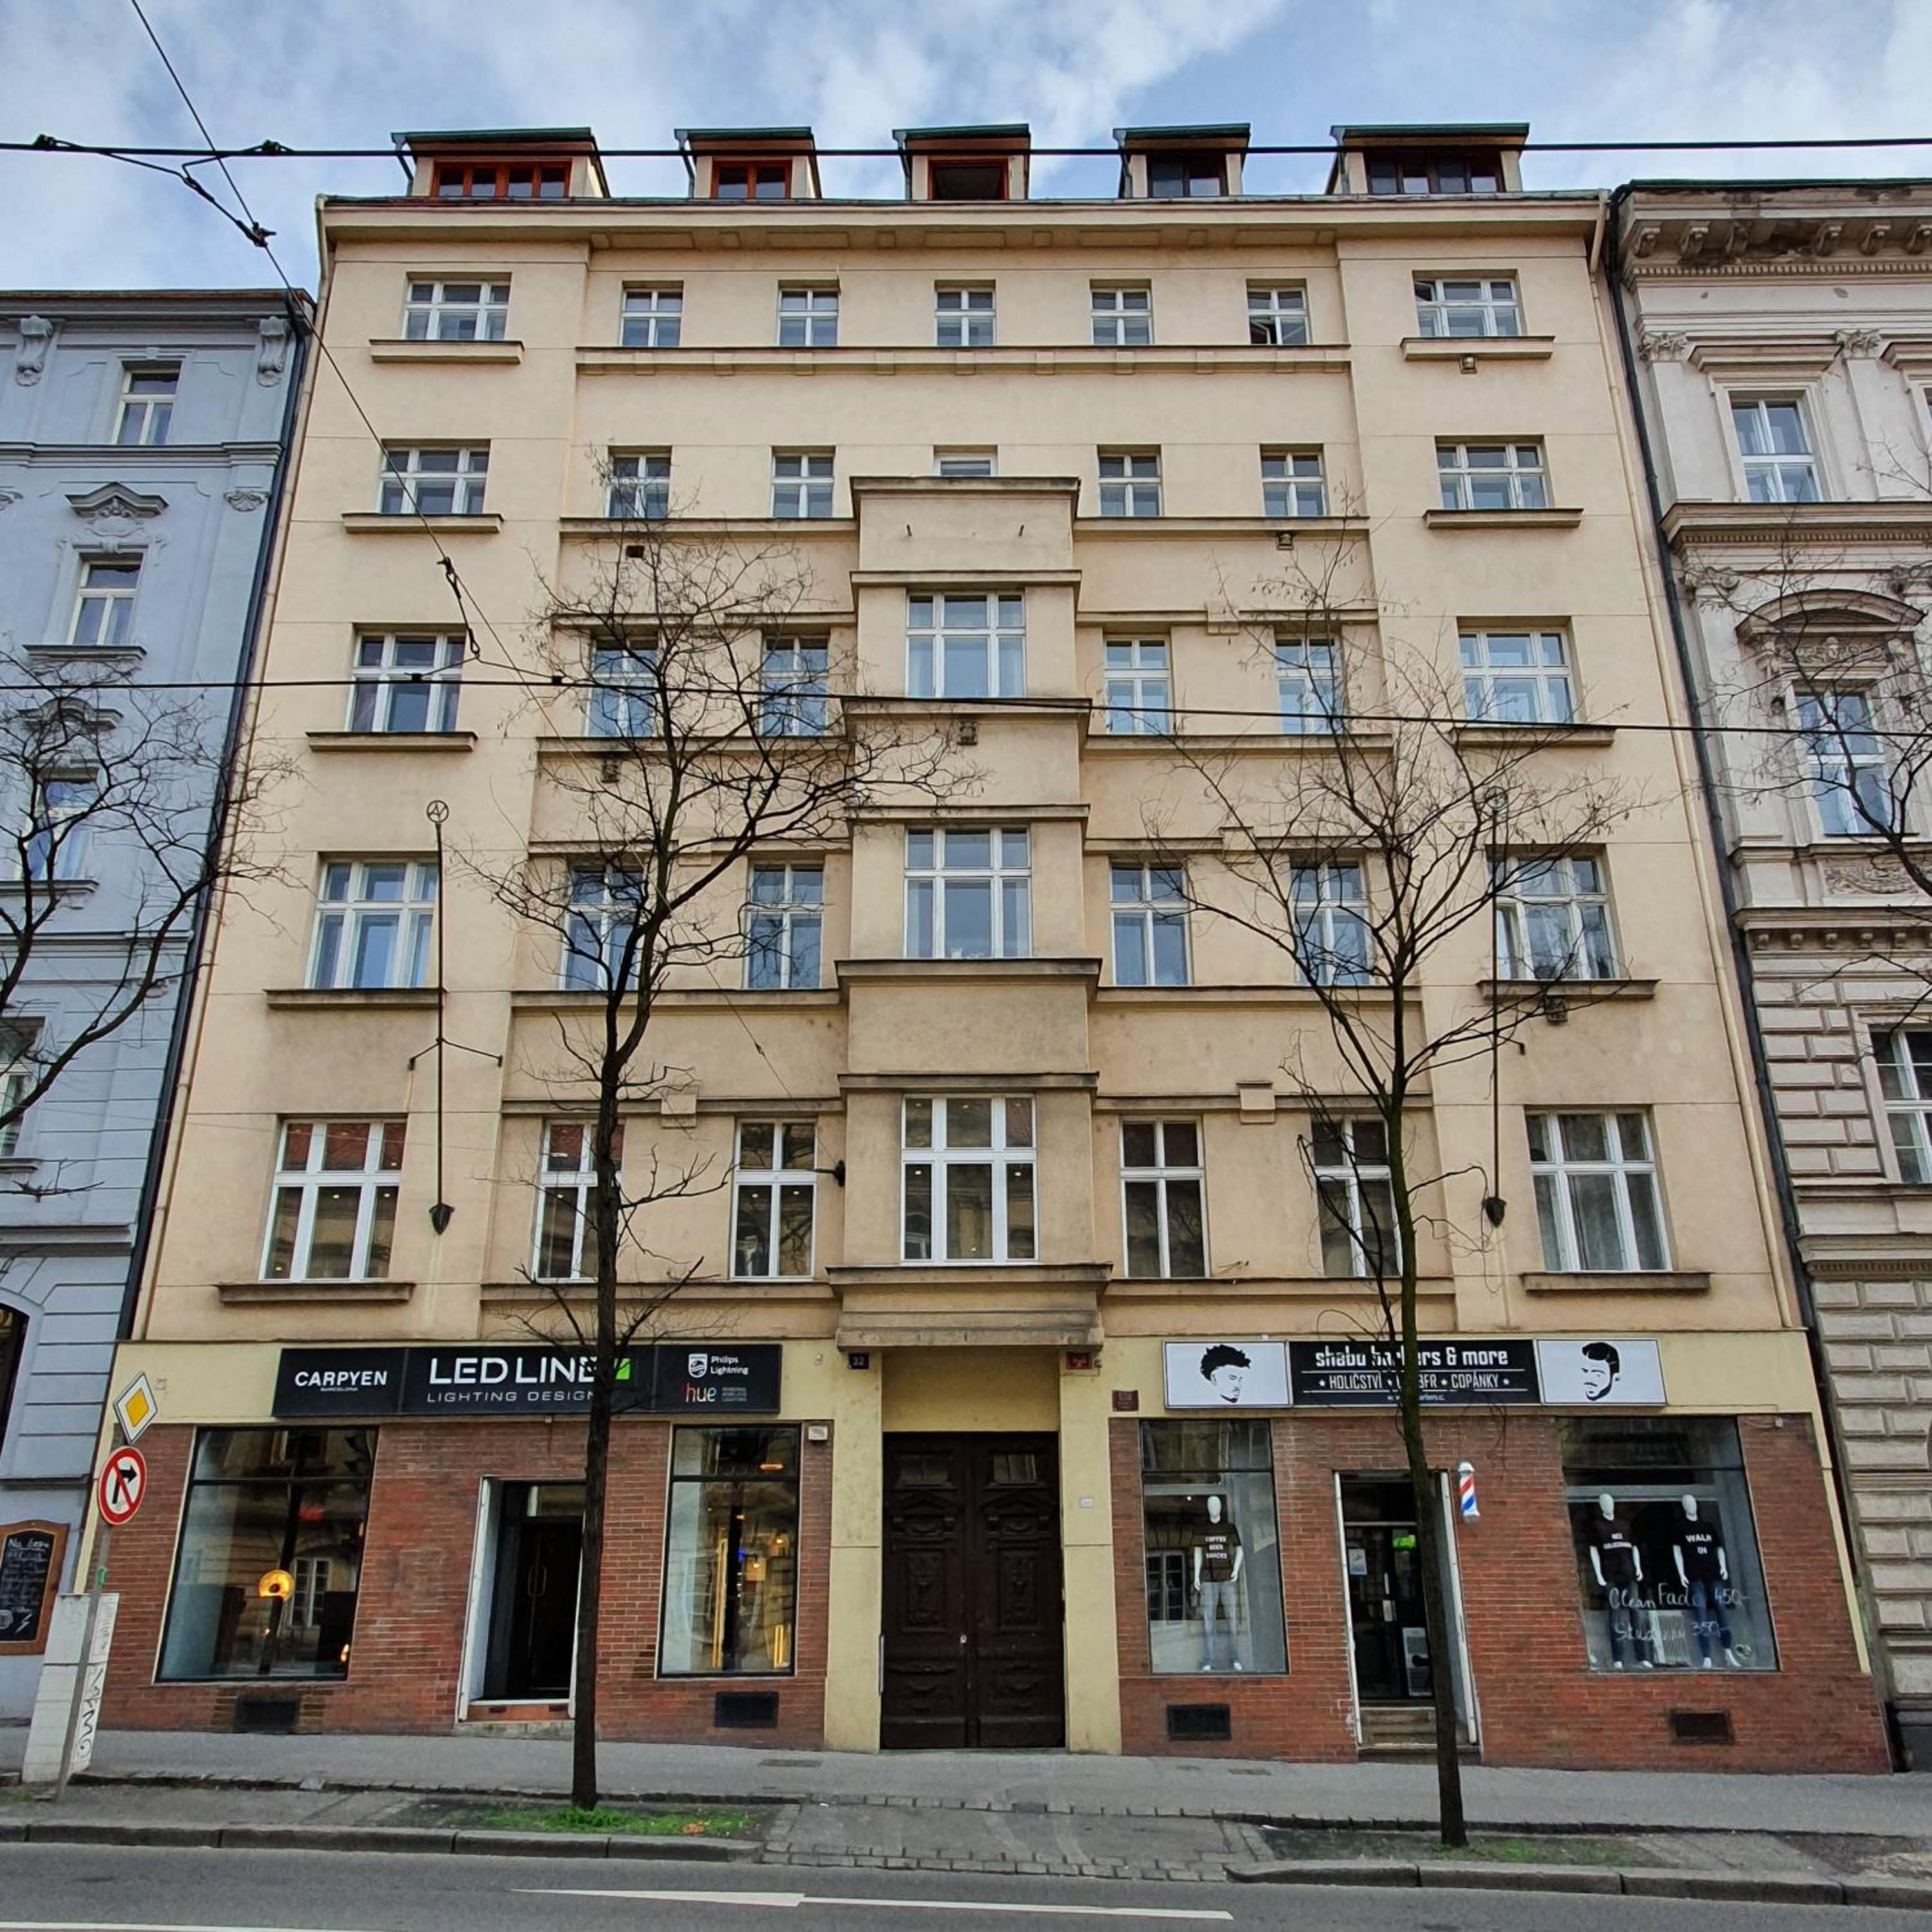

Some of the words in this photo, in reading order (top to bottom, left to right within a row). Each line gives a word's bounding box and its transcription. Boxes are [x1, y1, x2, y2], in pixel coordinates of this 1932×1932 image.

[1316, 1345, 1367, 1367] shabu
[1446, 1346, 1457, 1365] &
[1463, 1350, 1508, 1365] more
[294, 1370, 388, 1387] CARPYEN
[1329, 1371, 1382, 1389] HOLIČSTVÍ
[1450, 1372, 1499, 1388] COPÁNKY
[427, 1391, 517, 1403] LIGHTING
[685, 1382, 717, 1402] hue
[1609, 1587, 1656, 1609] Clean
